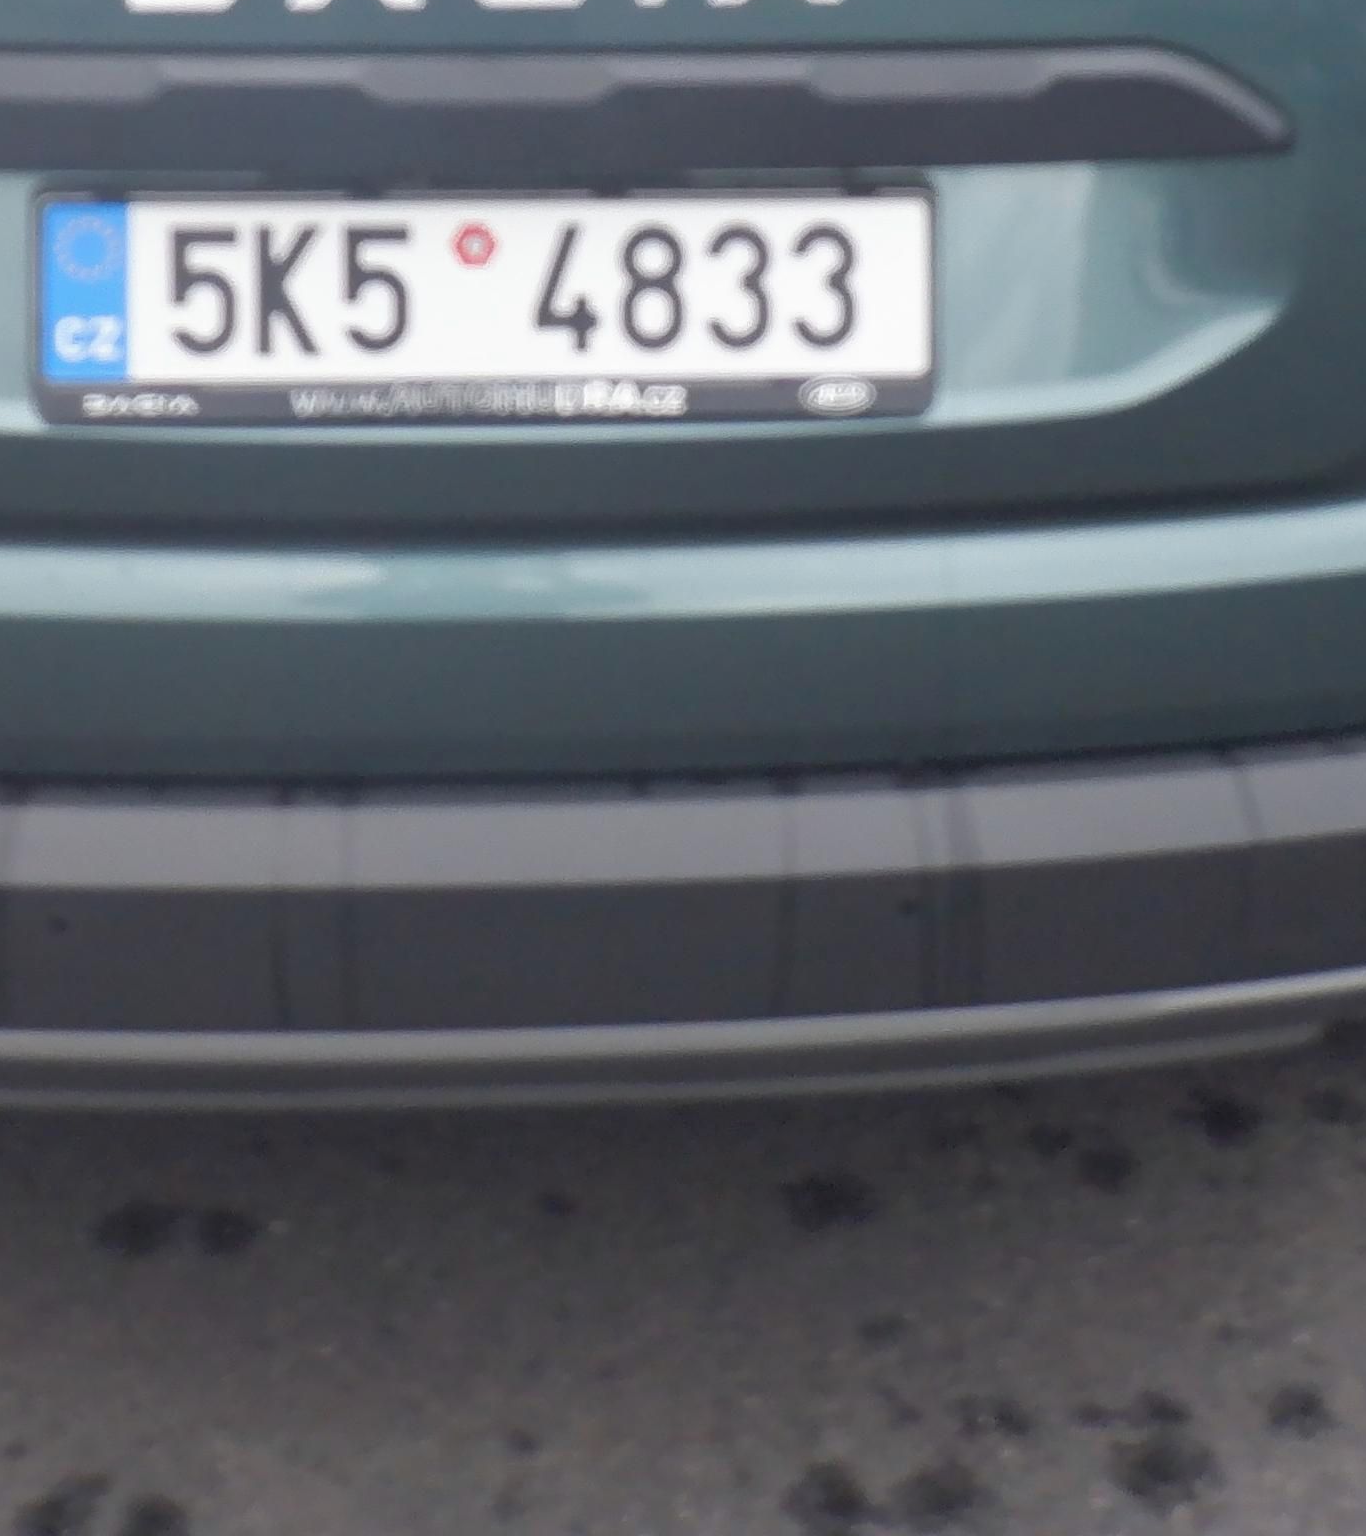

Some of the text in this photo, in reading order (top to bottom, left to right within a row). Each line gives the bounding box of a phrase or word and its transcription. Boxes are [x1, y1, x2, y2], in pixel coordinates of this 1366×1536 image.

[167, 220, 858, 356] 5K5 4833
[54, 315, 123, 363] CZ
